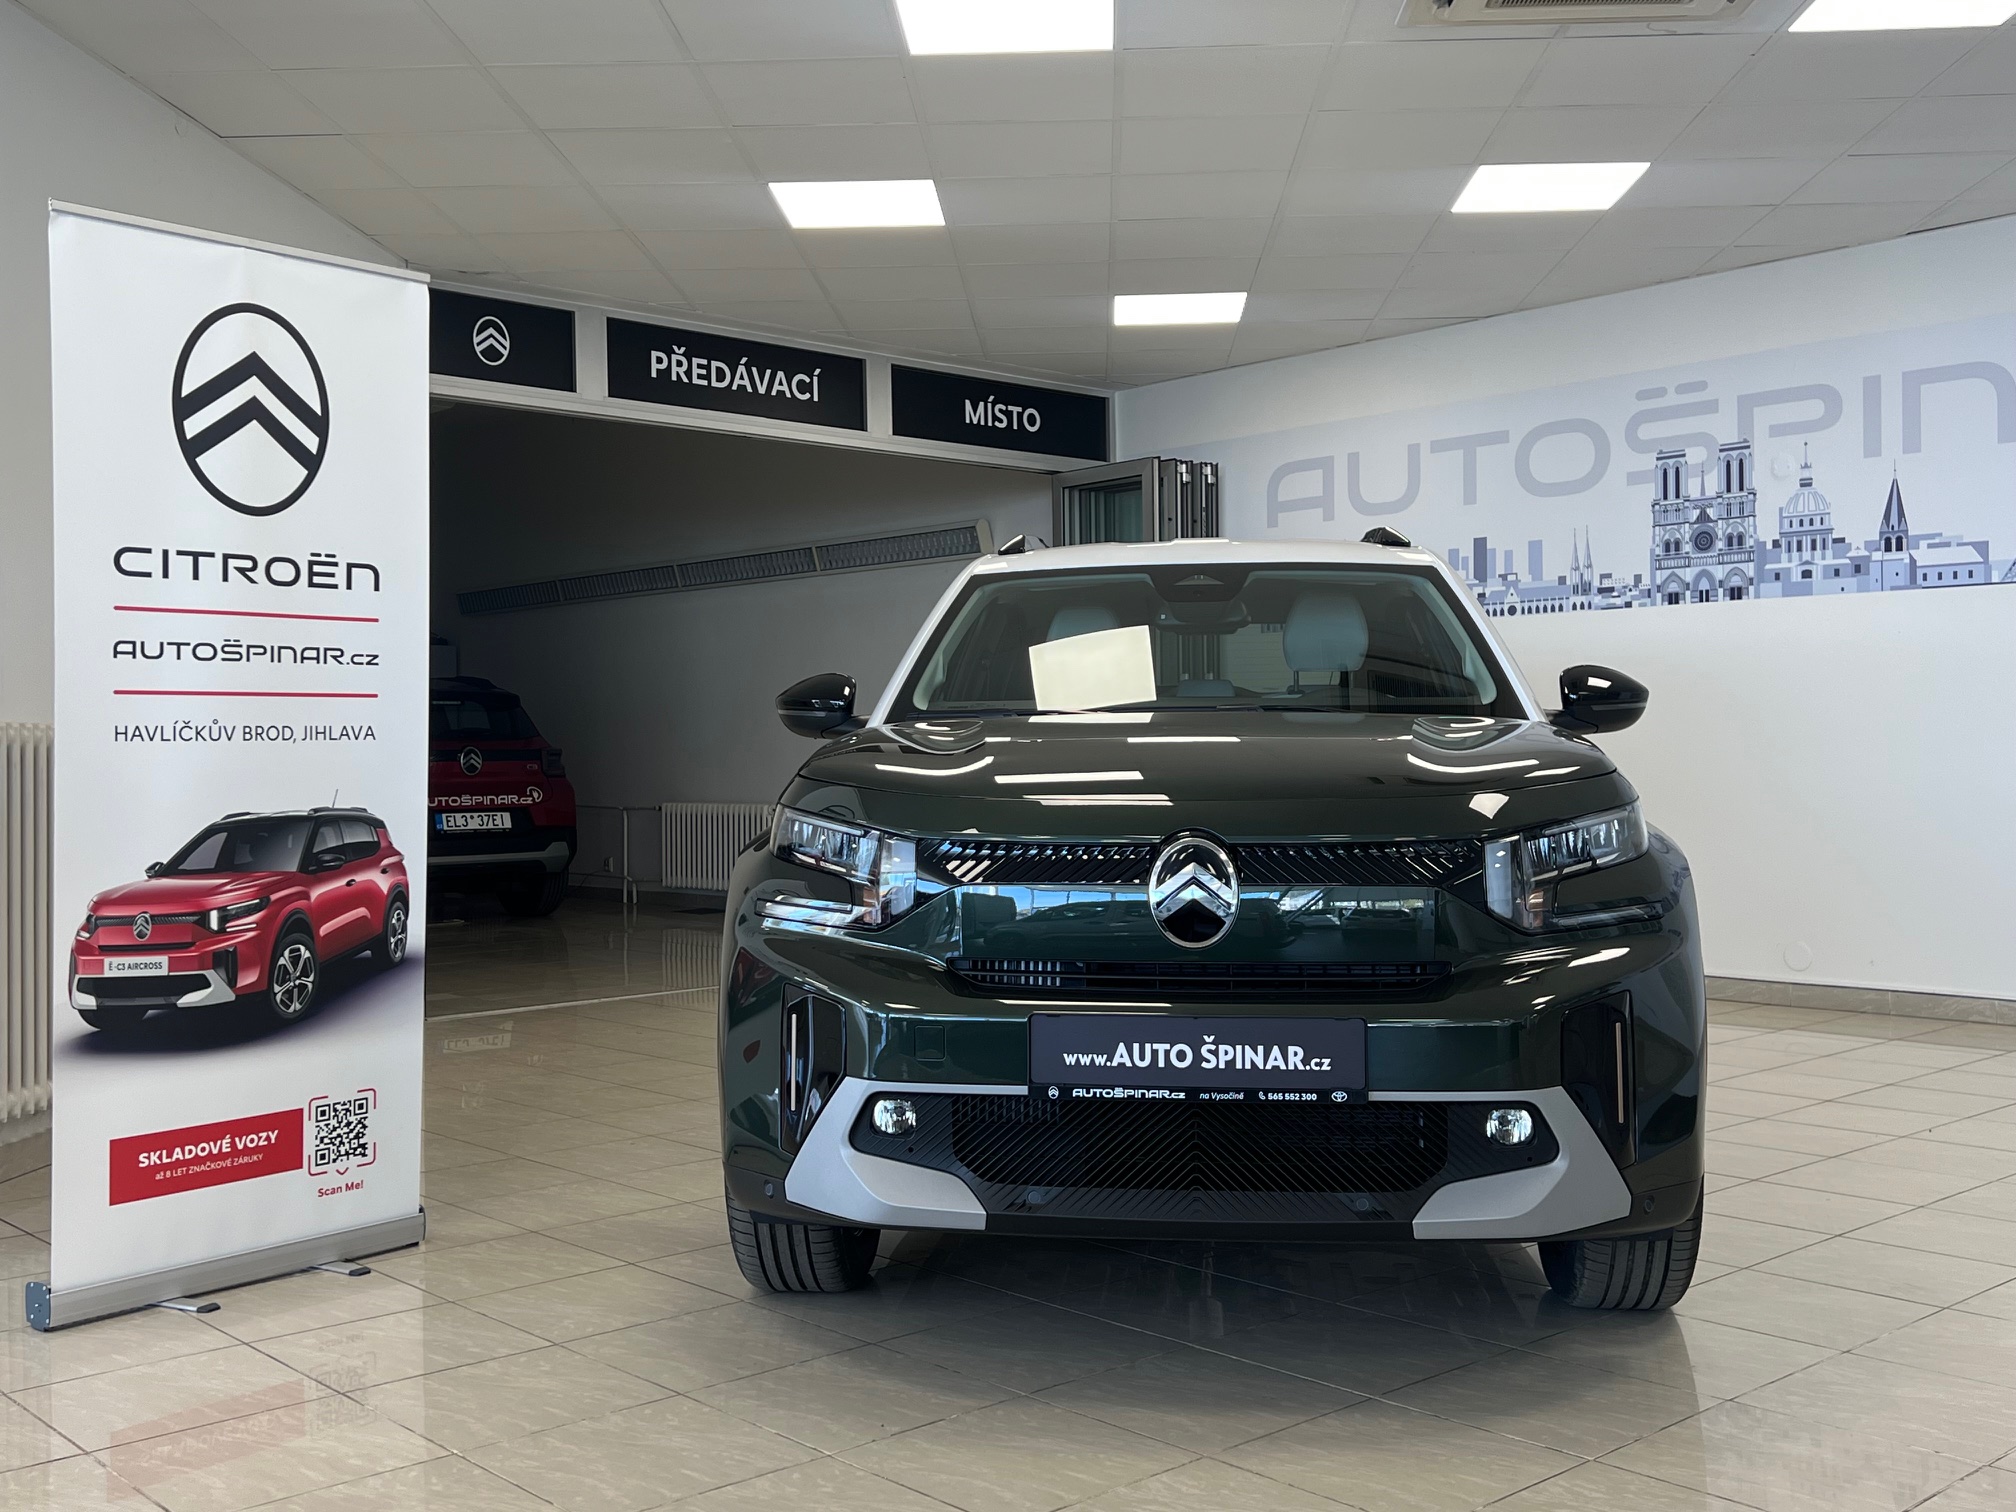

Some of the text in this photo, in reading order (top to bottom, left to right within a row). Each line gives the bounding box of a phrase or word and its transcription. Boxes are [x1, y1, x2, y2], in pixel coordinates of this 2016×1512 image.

[649, 344, 1041, 433] PŘEDÁVACÍ MÍSTO
[113, 546, 380, 592] CITROËN
[114, 719, 376, 744] HAVLÍČKŮV BROD, JIHLAVA
[428, 794, 533, 807] UTOŠPINAR.cz
[127, 962, 163, 970] AIRCROSS
[1063, 1035, 1332, 1072] www.AUTO ŠPINAR.cz
[1267, 1092, 1284, 1100] 565
[1284, 1093, 1300, 1101] 552
[1301, 1093, 1318, 1101] 300
[138, 1130, 279, 1168] SKLADOVÉ VOZY
[155, 1153, 263, 1180] až 8 LET ZNAČKOVÉ ZÁRUKY
[318, 1179, 364, 1198] Scan Me!
